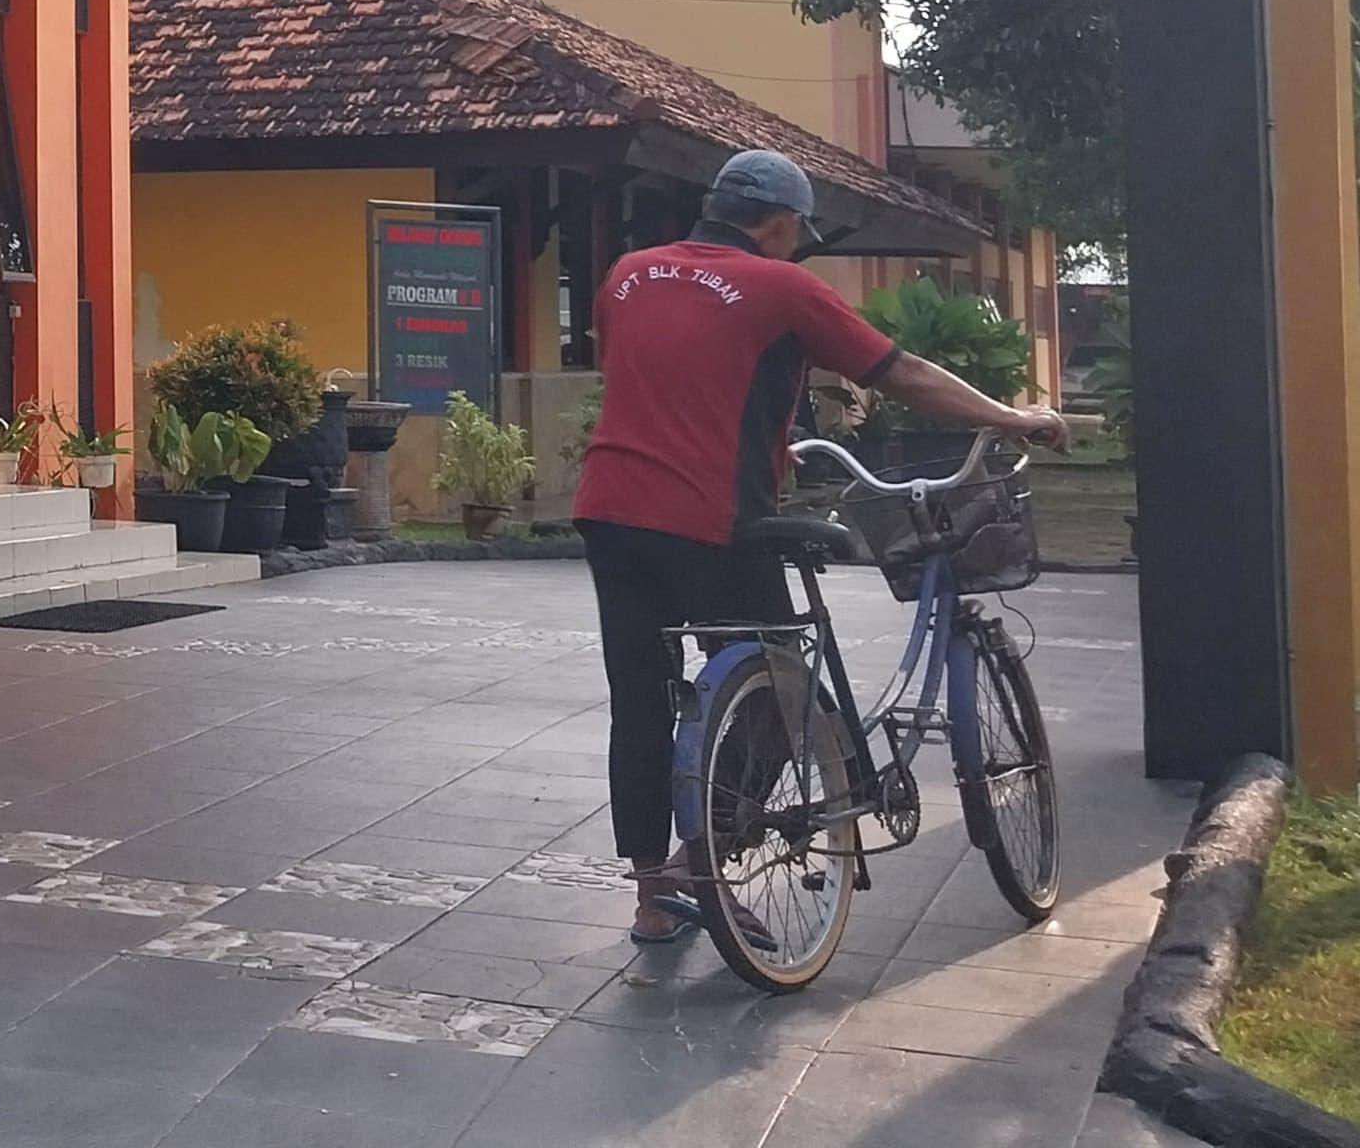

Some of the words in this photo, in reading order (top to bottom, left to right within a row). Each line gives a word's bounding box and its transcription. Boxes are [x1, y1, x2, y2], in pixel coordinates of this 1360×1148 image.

[387, 284, 458, 305] PROGRAM
[613, 272, 641, 301] UPT
[648, 265, 681, 280] BLK
[691, 268, 743, 304] TUBAN
[407, 354, 449, 369] RESIK
